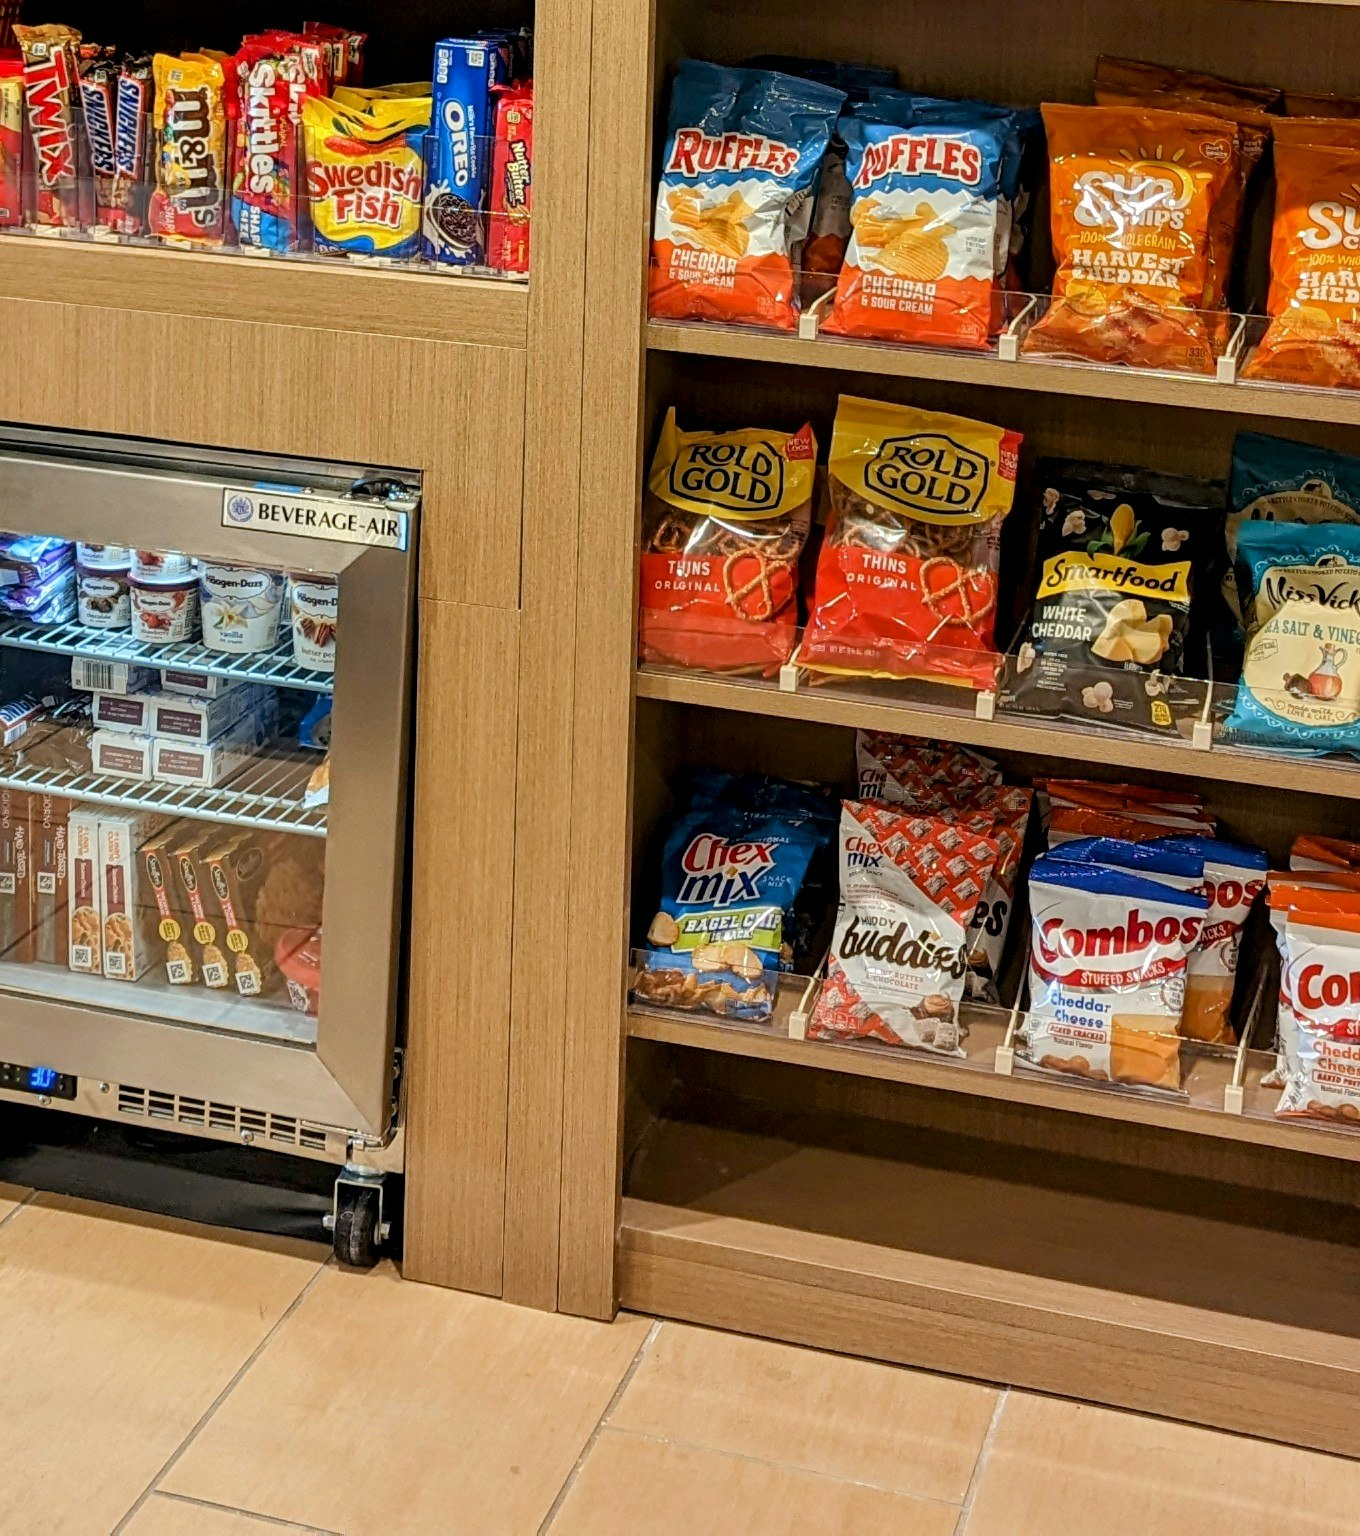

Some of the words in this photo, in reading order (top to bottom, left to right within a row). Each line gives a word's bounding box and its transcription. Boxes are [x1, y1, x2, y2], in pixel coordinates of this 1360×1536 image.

[25, 46, 74, 186] TWIX
[82, 81, 115, 174] SNICKERS
[115, 78, 141, 178] SNICKERS
[248, 64, 280, 194] Skittles
[444, 100, 469, 187] OREO
[670, 128, 800, 176] RUFFLES
[855, 134, 983, 186] RUFFLES
[306, 160, 421, 202] Swedish
[330, 187, 402, 226] Fish
[670, 248, 737, 275] CHEDDAR
[1072, 248, 1186, 275] HARVEST
[1308, 253, 1335, 267] 100%
[702, 273, 735, 289] CREAM
[861, 274, 936, 302] CHEDDAR
[1072, 266, 1180, 291] CHEDDAR
[871, 295, 896, 311] SOUR
[898, 298, 933, 315] CREAM
[689, 443, 773, 476] ROLD
[889, 446, 979, 480] ROLD
[681, 467, 772, 504] GOLD
[876, 465, 972, 503] GOLD
[258, 502, 400, 537] BEVERAGE-AIR
[667, 560, 711, 576] THINS
[861, 553, 908, 575] THINS
[1045, 558, 1178, 592] Smartfood
[654, 580, 721, 593] ORIGINAL
[845, 572, 918, 592] ORIGINAL
[1266, 576, 1316, 611] Miss
[1042, 605, 1087, 623] WHITE
[1282, 620, 1310, 637] SALT
[1031, 622, 1092, 642] CHEDDAR
[682, 834, 780, 874] Chex
[844, 836, 890, 857] Chex
[847, 852, 883, 869] mix
[677, 865, 768, 907] mix
[684, 913, 740, 932] BAGEL
[1037, 908, 1205, 964] Combos
[839, 917, 968, 980] buddies
[1080, 969, 1124, 985] STUFFED
[1049, 990, 1112, 1013] Cheddar
